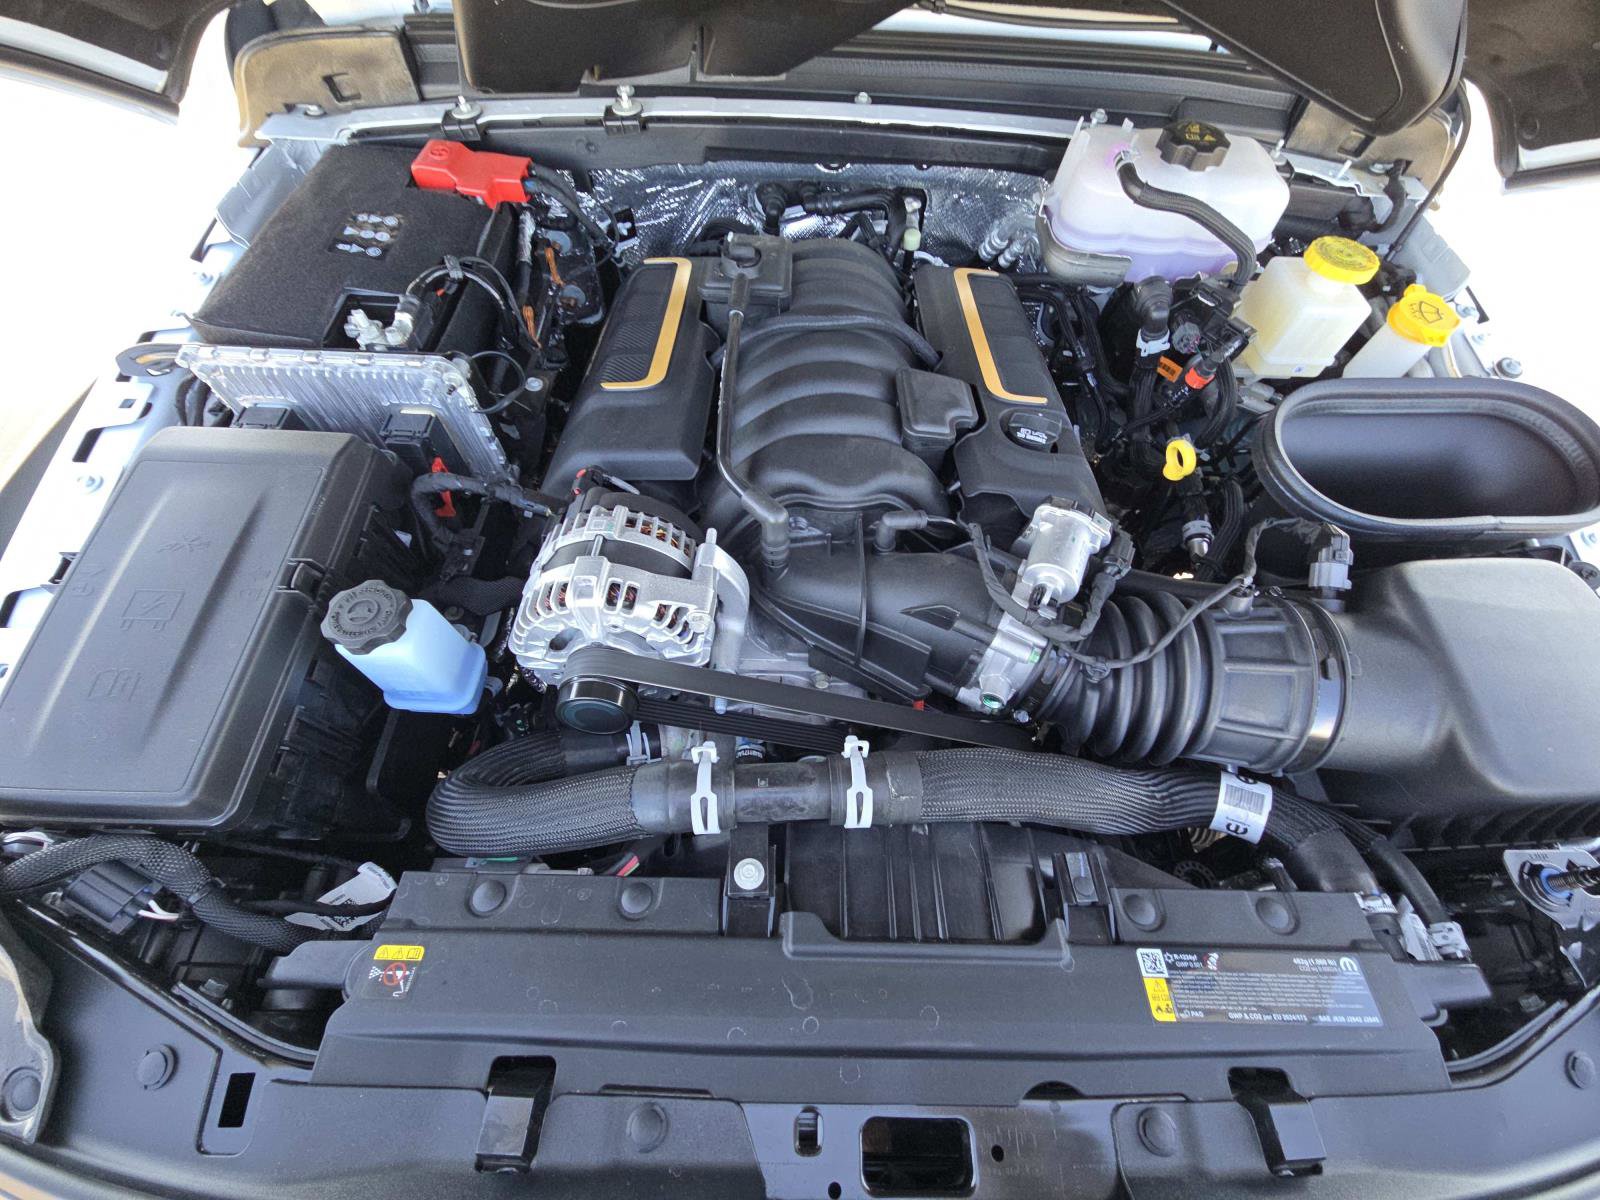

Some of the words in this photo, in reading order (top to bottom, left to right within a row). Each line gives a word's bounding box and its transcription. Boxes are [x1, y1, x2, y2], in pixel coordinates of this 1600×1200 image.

[1173, 954, 1198, 962] R-1234yf
[1228, 1012, 1243, 1020] GWP
[1249, 1013, 1262, 1021] CO2
